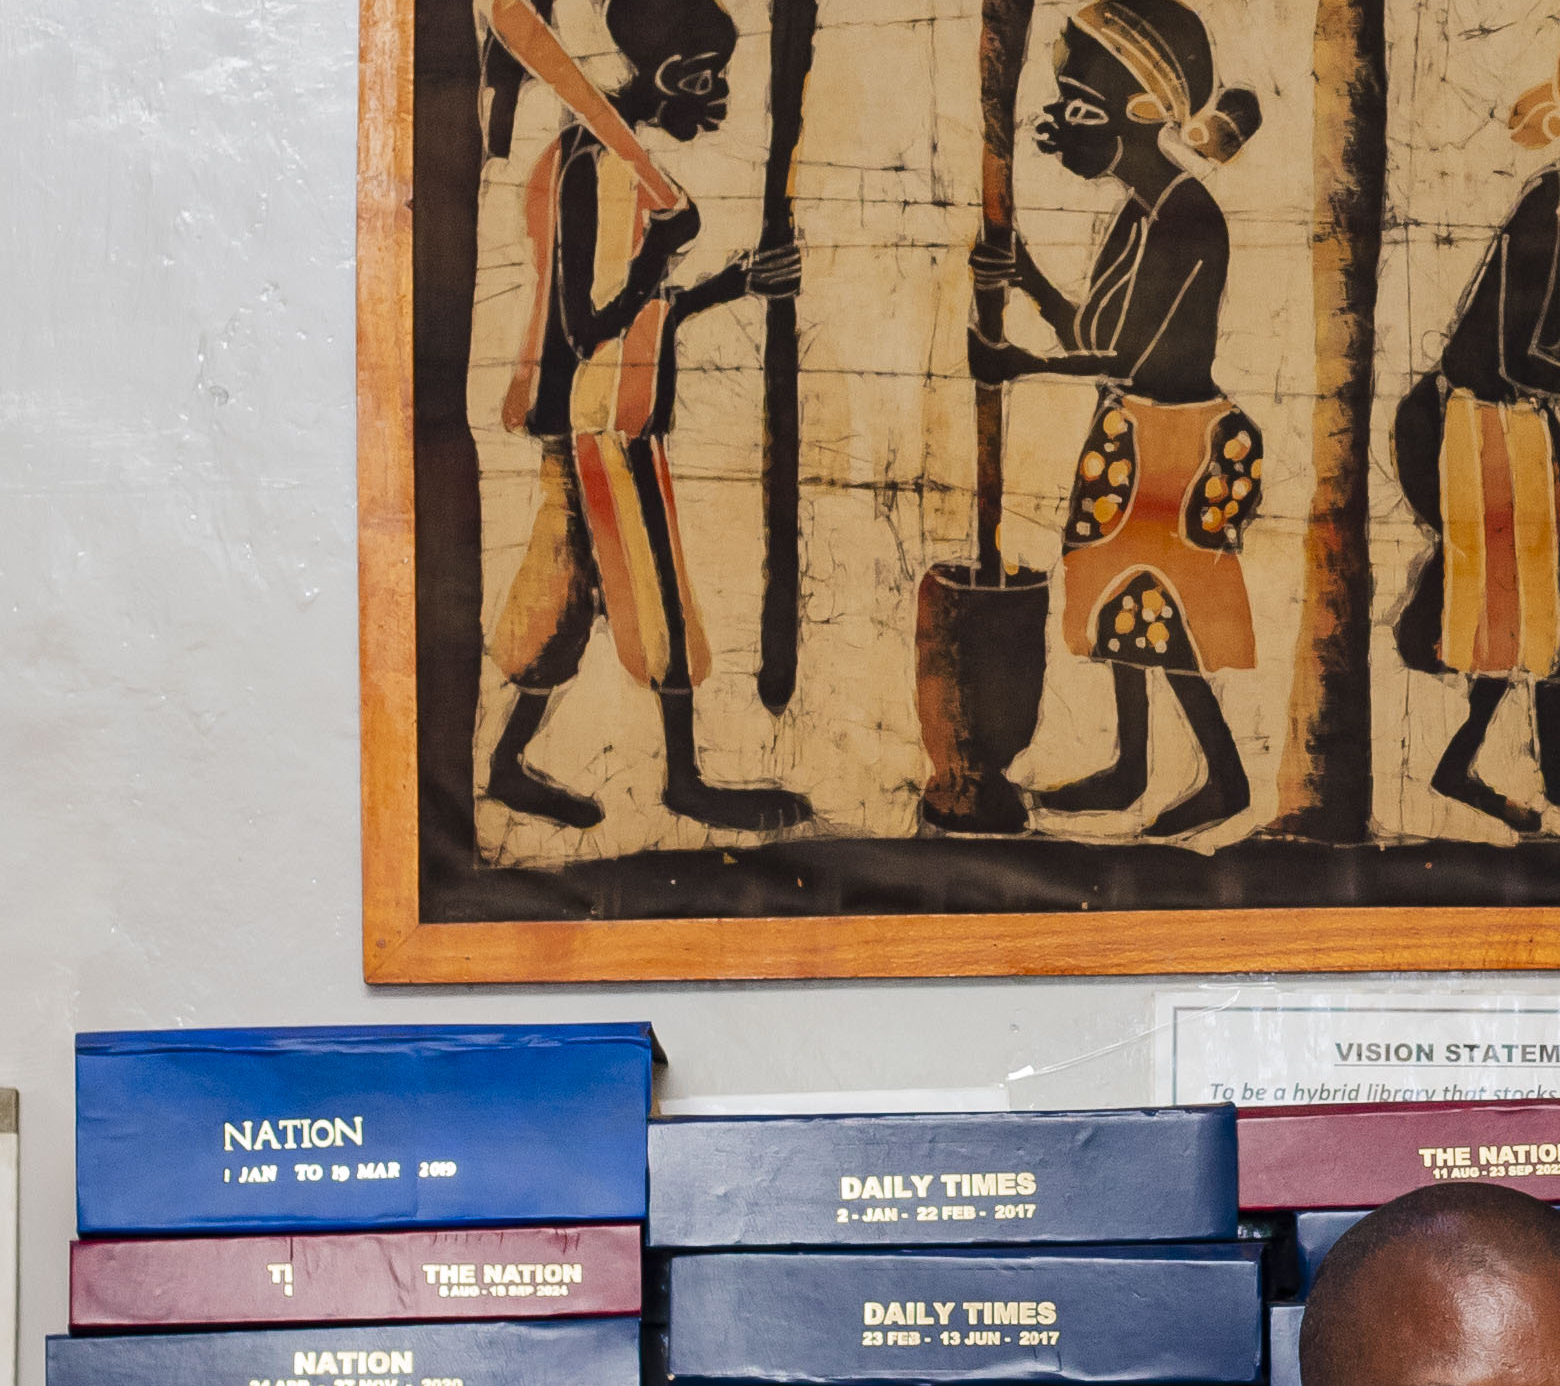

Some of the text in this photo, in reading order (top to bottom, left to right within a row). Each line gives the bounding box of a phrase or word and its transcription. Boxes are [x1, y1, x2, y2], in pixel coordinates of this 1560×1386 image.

[1334, 1042, 1434, 1062] VISION
[1210, 1083, 1234, 1101] To
[1242, 1083, 1265, 1100] be
[1274, 1088, 1286, 1100] a
[1293, 1084, 1360, 1103] hybrid
[224, 1117, 362, 1151] NATION
[1419, 1148, 1471, 1167] THE
[224, 1169, 230, 1182] 1
[239, 1165, 277, 1183] JAN
[295, 1164, 323, 1181] TO
[357, 1162, 400, 1179] MAR
[419, 1162, 456, 1177] 2019
[841, 1173, 1036, 1199] DAILY TIMES
[423, 1264, 582, 1283] THE NATION
[864, 1302, 1056, 1325] DAILY TIMES
[294, 1351, 412, 1375] NATION
